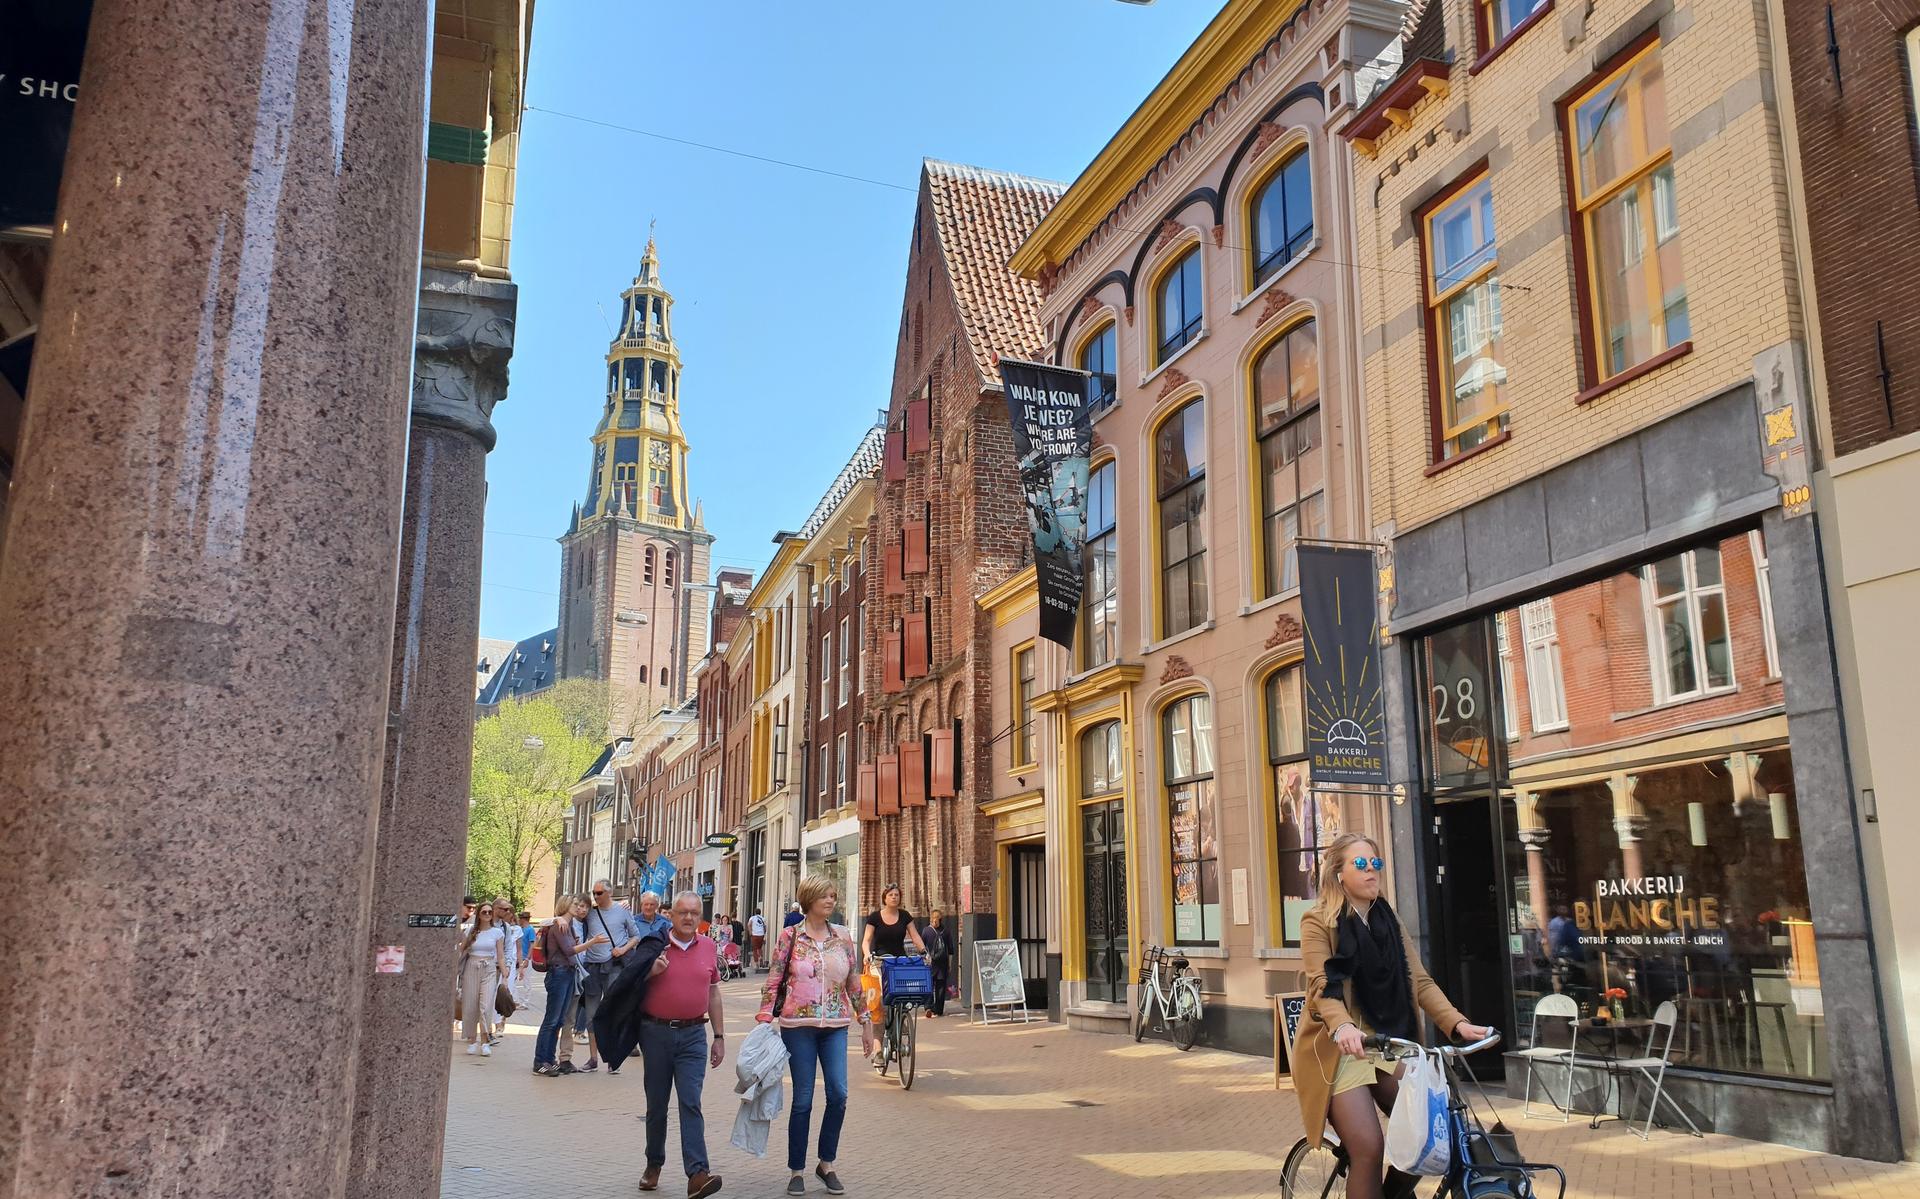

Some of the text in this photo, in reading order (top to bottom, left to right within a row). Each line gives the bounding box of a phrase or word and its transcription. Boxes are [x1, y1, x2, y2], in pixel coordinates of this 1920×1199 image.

[1049, 391, 1081, 407] KOM
[1024, 405, 1037, 420] JE
[1026, 423, 1077, 441] WHRE ARE
[1043, 442, 1077, 456] FROM?
[1432, 678, 1475, 725] 28
[1328, 747, 1368, 756] BAKKERIJ
[1315, 754, 1382, 769] BLANCHE
[1599, 876, 1684, 896] BAKKERIJ
[1574, 898, 1719, 930] BLANCHE
[1578, 936, 1608, 945] ONTBIJT
[1616, 936, 1643, 945] BROOD
[1645, 936, 1651, 945] &
[1654, 936, 1685, 945] BANKET
[1694, 936, 1724, 945] LUNCH
